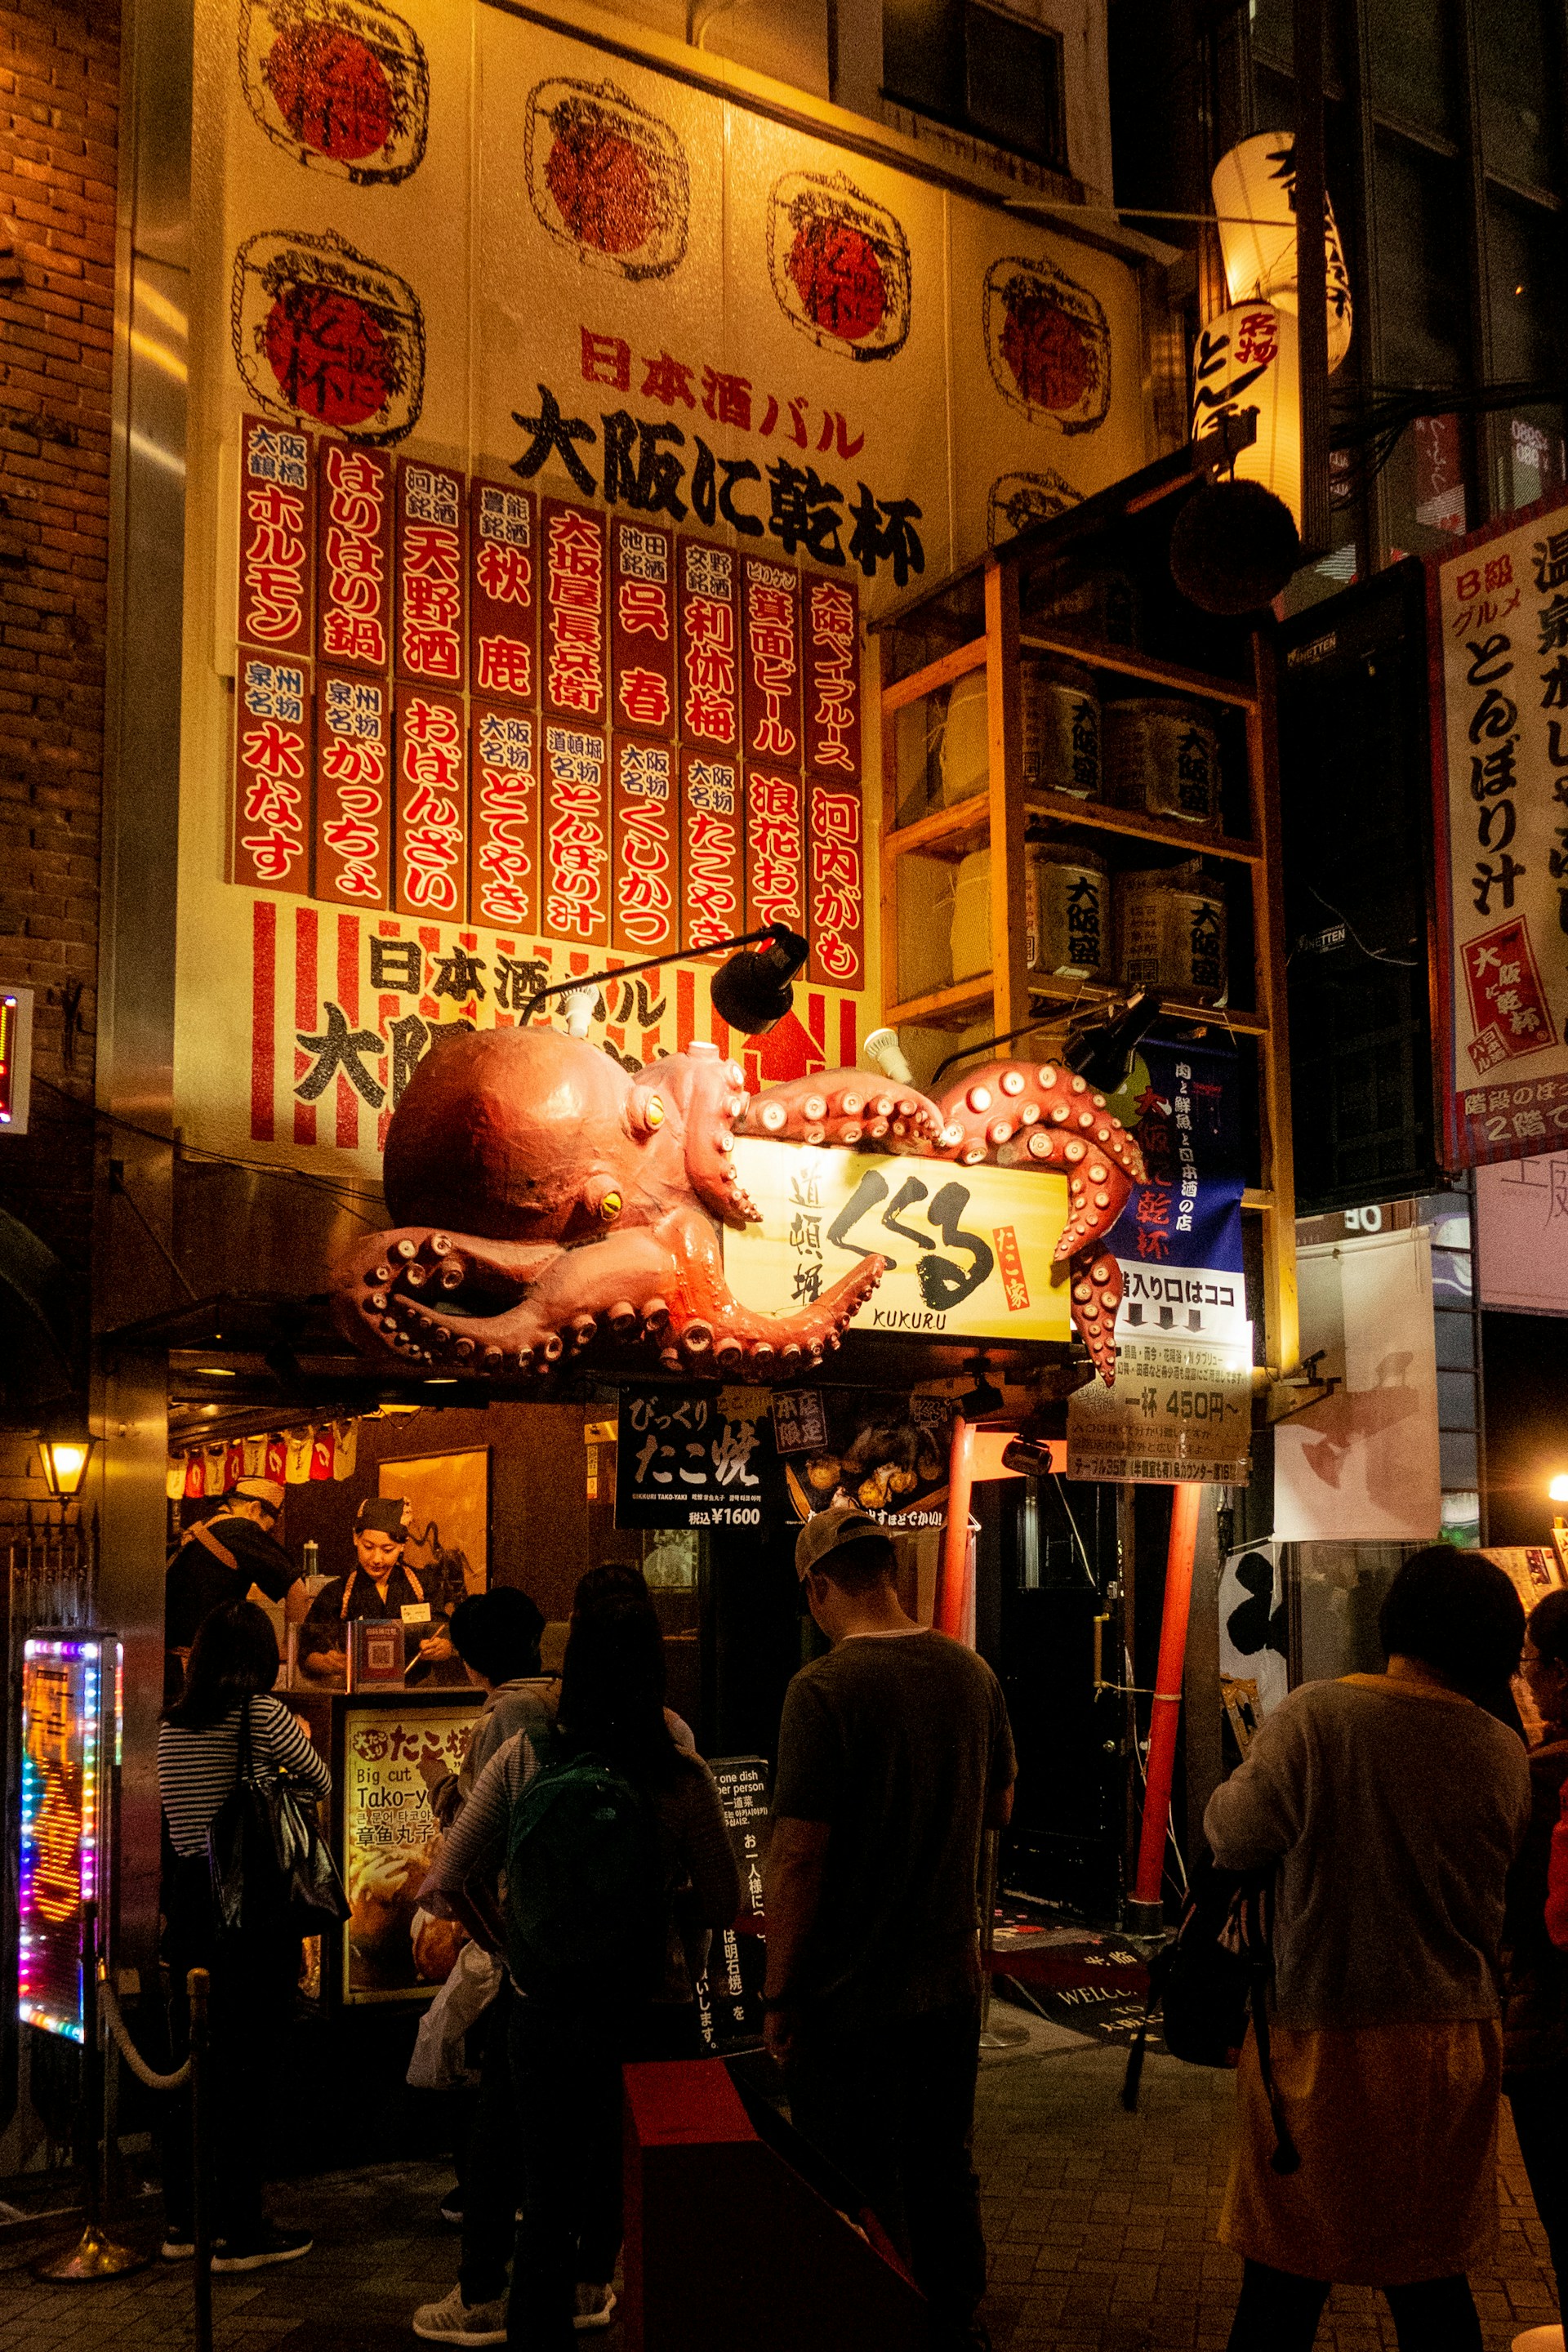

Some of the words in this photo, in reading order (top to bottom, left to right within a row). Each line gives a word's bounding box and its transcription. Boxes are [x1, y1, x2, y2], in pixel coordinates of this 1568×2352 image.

[1235, 312, 1278, 364] 名物
[581, 326, 865, 460] 日本酒バル
[508, 383, 925, 587] 大阪に乾杯
[246, 483, 305, 641] ホルモン
[324, 447, 385, 665] はりはり鍋
[403, 527, 461, 680] 天野酒
[478, 542, 531, 696] 秋鹿
[246, 661, 303, 697] 泉州
[619, 581, 670, 725] 呉春
[684, 596, 736, 745] 利休梅
[747, 583, 797, 755] 箕面ビール
[246, 689, 304, 724] 名物
[326, 708, 383, 741] 名物
[327, 679, 382, 715] 泉州
[480, 713, 531, 745] 大阪
[480, 737, 531, 772] 名物
[546, 726, 604, 763] 道頓堀
[550, 755, 601, 787] 名物
[621, 743, 668, 775] 大阪
[688, 760, 735, 792] 大阪
[1465, 633, 1526, 916] とんぼり汁
[242, 721, 305, 881] 水なす
[403, 698, 462, 911] おばんざい
[621, 768, 668, 800] 名物
[688, 785, 735, 815] 名物
[323, 737, 386, 900] がっちょ
[480, 768, 536, 924] どてやき
[547, 779, 608, 936] とんぼり汁
[618, 799, 671, 946] くしかつ
[688, 811, 737, 959] たこやき
[749, 773, 801, 954] 浪花おで
[811, 788, 862, 980] 河内がも
[1066, 876, 1100, 966] 大阪盛
[1174, 1061, 1199, 1232] 肉と鮮魚と日本酒の店
[789, 1158, 823, 1307] 道頓堀
[826, 1169, 995, 1312] くくる
[995, 1227, 1030, 1311] たこ家
[872, 1307, 947, 1331] KUKURU
[628, 1395, 708, 1432] びっくり
[1125, 1386, 1157, 1418] 一杯
[634, 1421, 761, 1487] たこ焼
[657, 1493, 688, 1501] TAKO-YAKI
[710, 1507, 761, 1526] ¥1600
[356, 1766, 381, 1786] Big
[387, 1766, 412, 1783] cut
[356, 1785, 428, 1810] Tako-y
[719, 1773, 738, 1784] one
[739, 1769, 760, 1782] dish
[732, 1781, 765, 1797] person
[355, 1824, 435, 1847] 章鱼丸子
[371, 1810, 394, 1825] 문어
[397, 1808, 435, 1823] 타코야
